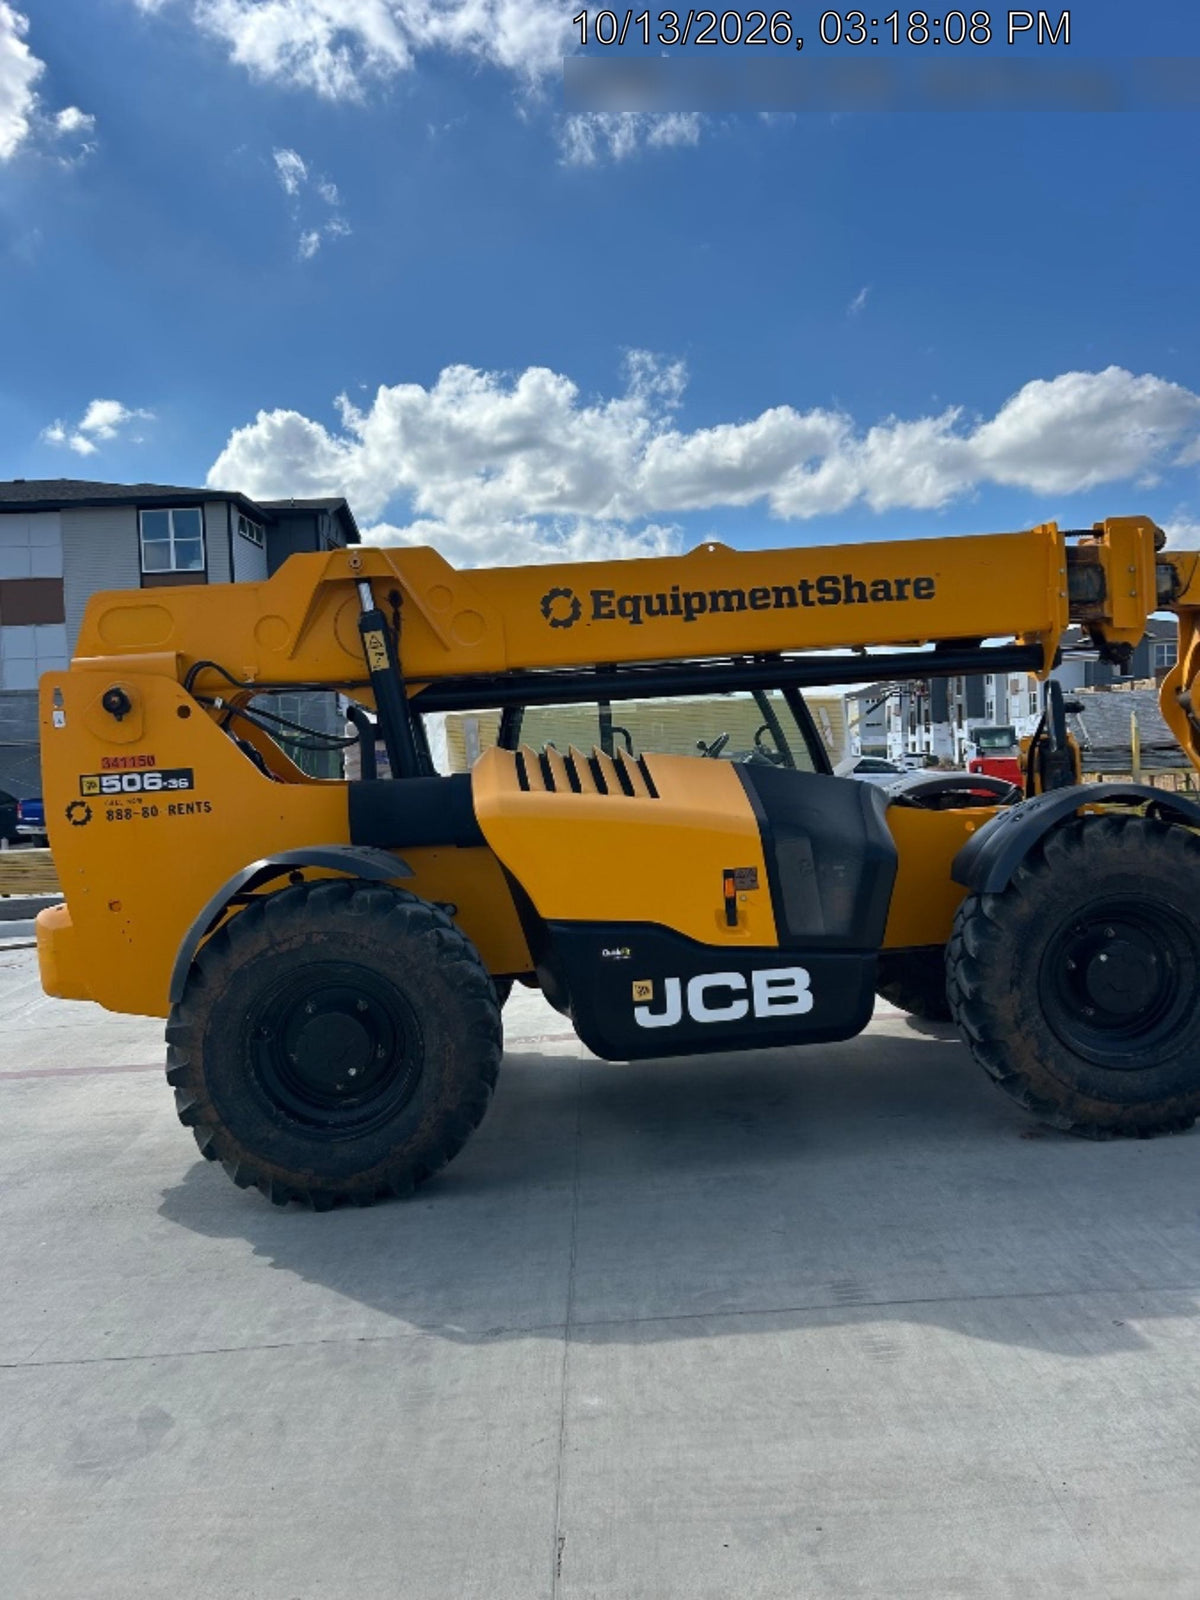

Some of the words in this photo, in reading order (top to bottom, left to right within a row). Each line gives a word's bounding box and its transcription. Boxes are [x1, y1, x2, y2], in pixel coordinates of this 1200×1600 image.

[591, 575, 935, 624] EquipmentShare
[102, 755, 156, 769] 341150
[168, 801, 213, 816] RENTS
[634, 966, 813, 1028] JCB
